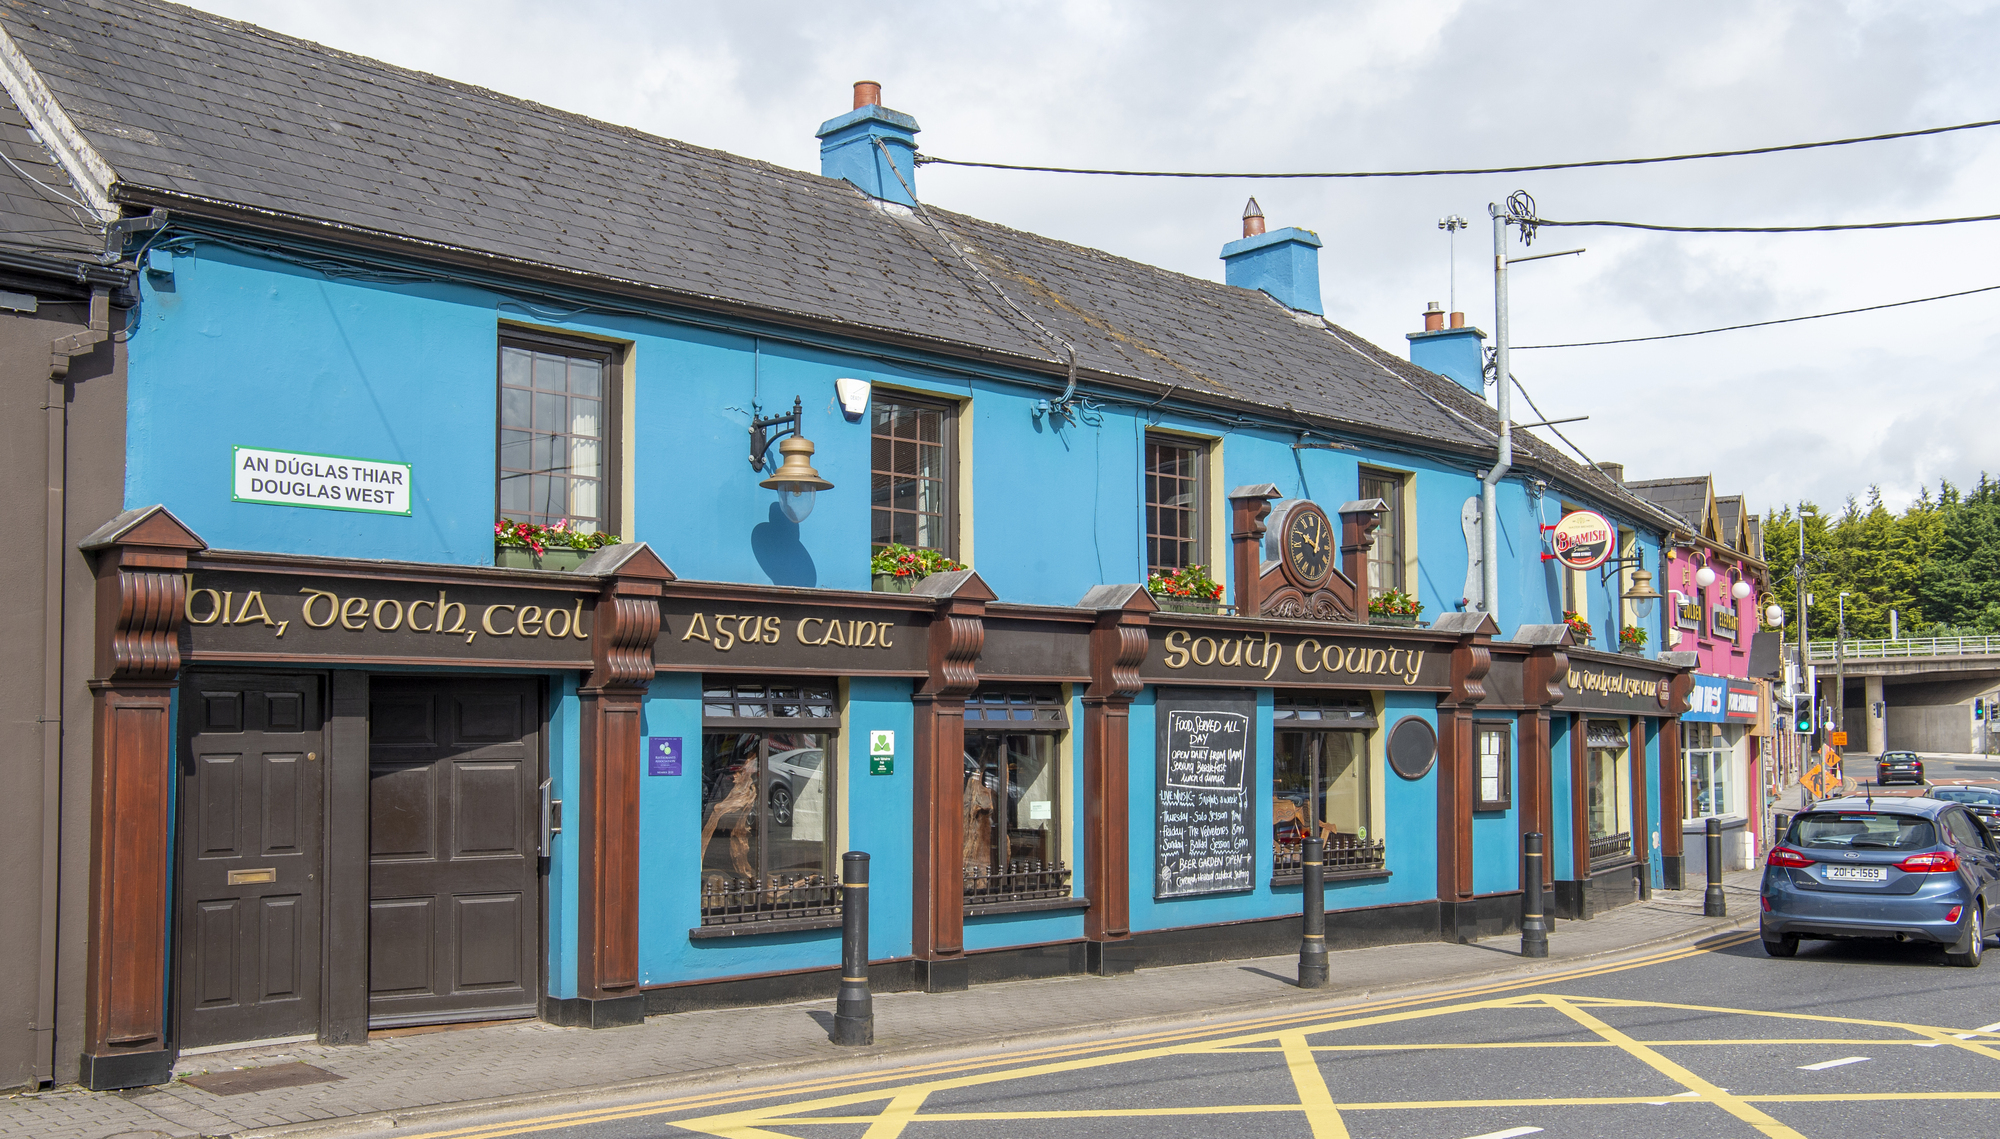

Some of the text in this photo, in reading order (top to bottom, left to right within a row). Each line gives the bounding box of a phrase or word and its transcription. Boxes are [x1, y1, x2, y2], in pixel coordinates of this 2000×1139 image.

[243, 456, 404, 486] AN DÚGLAS THIAR
[251, 478, 395, 505] DOUGLAS WEST
[1557, 530, 1606, 552] BEAMISH
[1164, 629, 1425, 685] South County
[1175, 715, 1241, 734] FOOD SERVED ALL
[1189, 732, 1209, 746] DAY
[1171, 749, 1190, 760] OPEN
[1190, 749, 1208, 761] DAILY
[1209, 749, 1226, 761] FROM
[1162, 810, 1189, 823] Thursday
[1192, 810, 1207, 823] Solo
[1208, 810, 1228, 823] Session
[1188, 825, 1199, 837] The
[1162, 838, 1185, 853] Sunday
[1209, 837, 1231, 851] Session
[1179, 853, 1243, 872] BEER GARDEN OPEN
[1833, 867, 1880, 878] 201-C-1569
